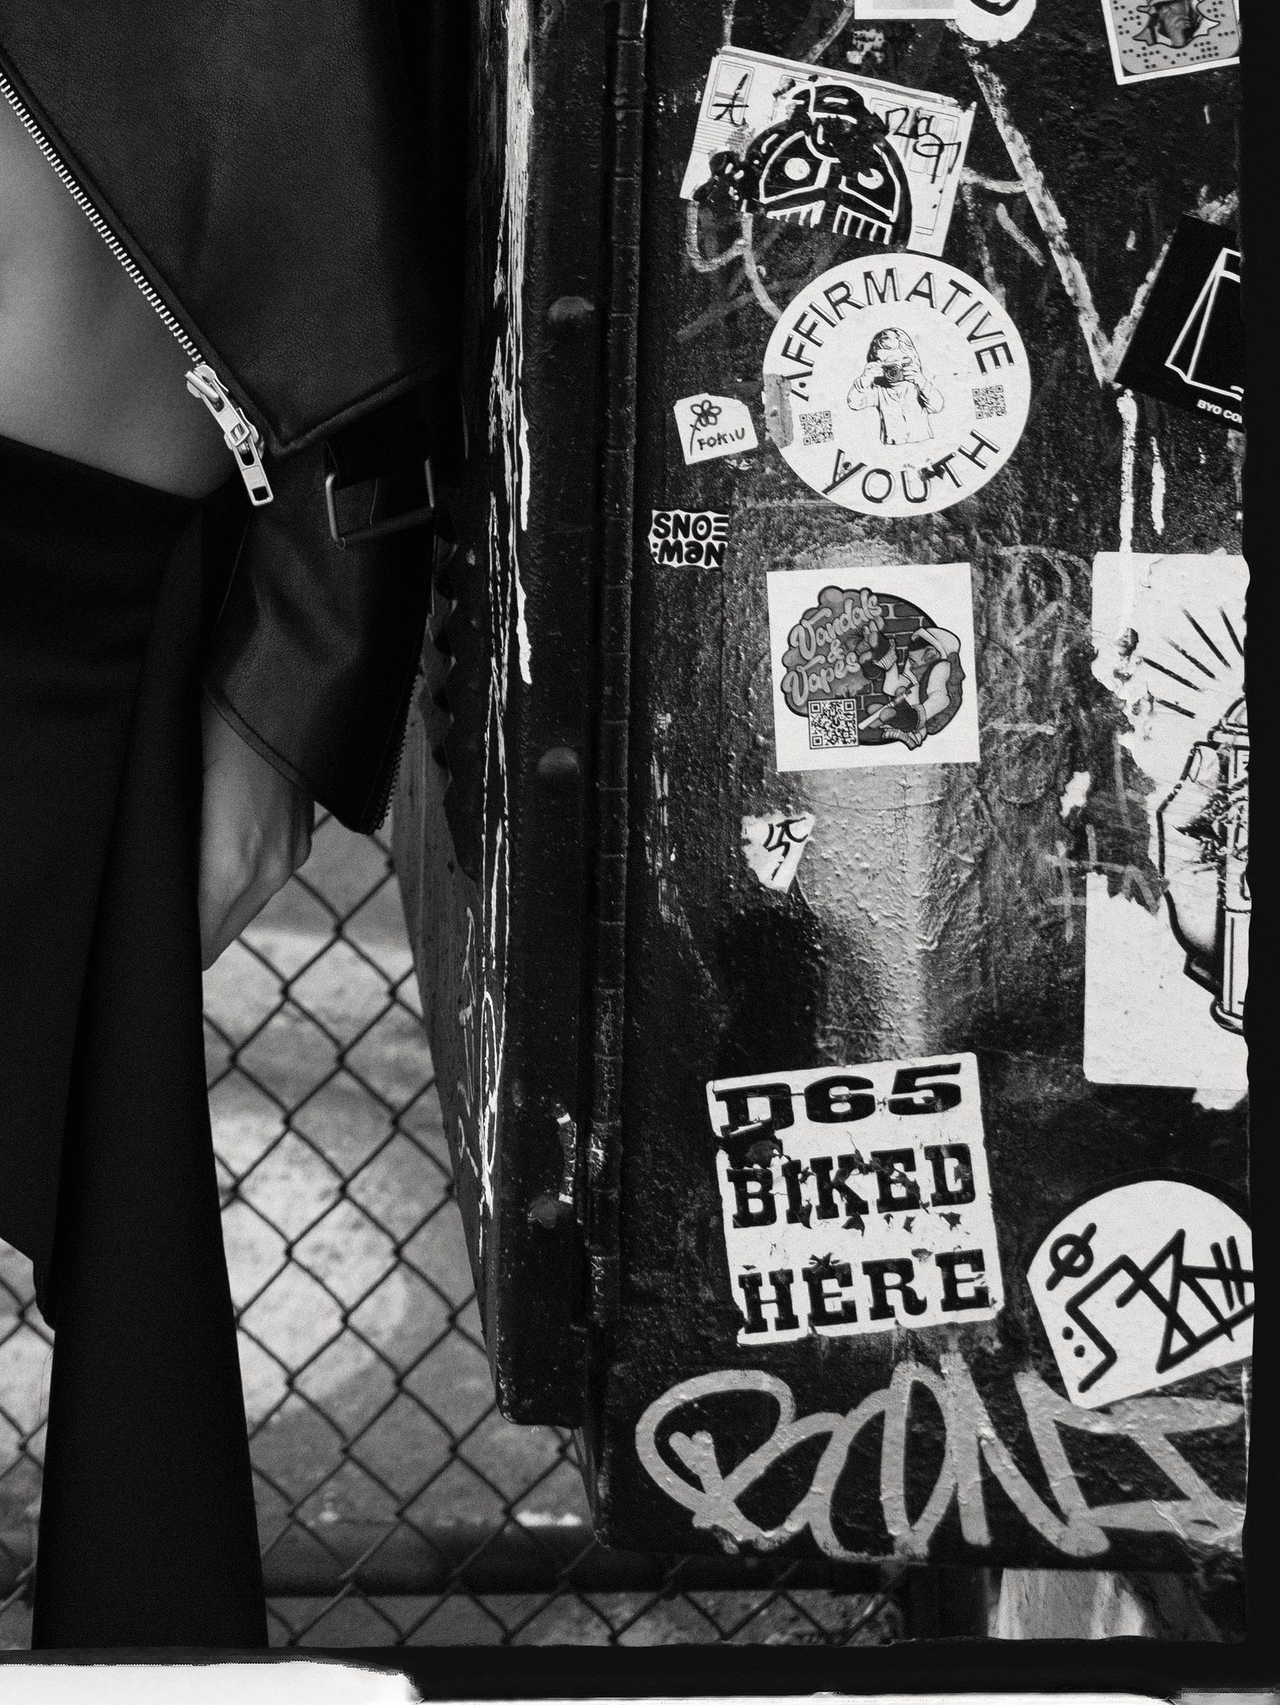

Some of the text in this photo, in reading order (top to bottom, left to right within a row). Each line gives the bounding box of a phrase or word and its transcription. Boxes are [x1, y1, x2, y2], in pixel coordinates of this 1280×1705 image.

[780, 267, 1015, 402] AFFIRMATIVE
[1196, 399, 1223, 415] BYO
[821, 428, 1001, 504] YOUTH
[789, 589, 883, 661] Vandals
[827, 638, 845, 664] &
[781, 651, 861, 706] Vapes
[713, 1062, 962, 1137] D65
[726, 1143, 976, 1229] BIKED
[738, 1248, 990, 1335] HERE
